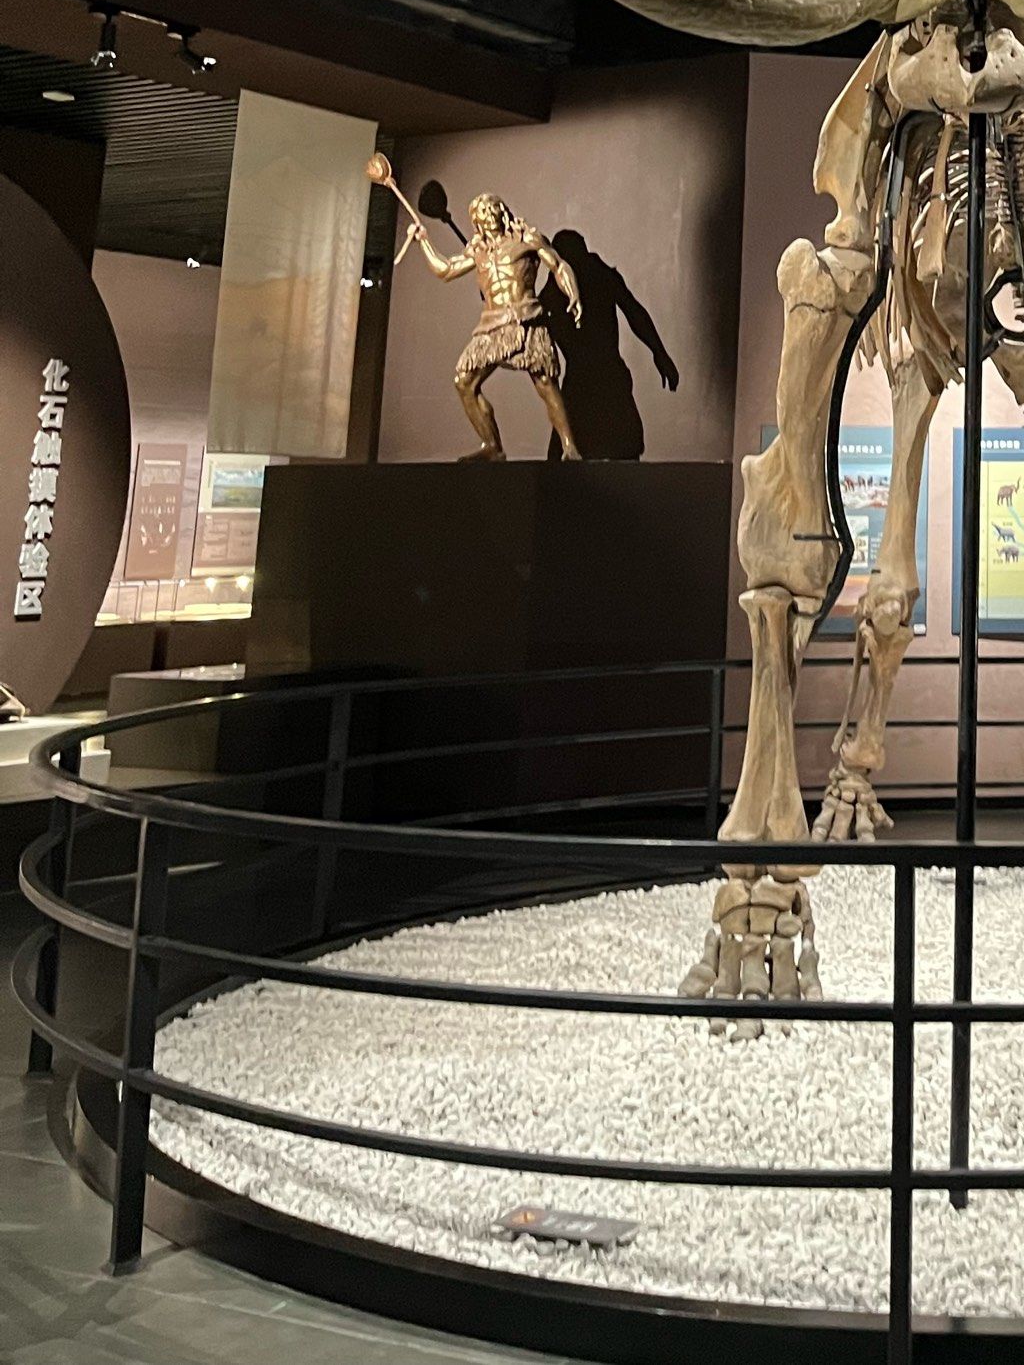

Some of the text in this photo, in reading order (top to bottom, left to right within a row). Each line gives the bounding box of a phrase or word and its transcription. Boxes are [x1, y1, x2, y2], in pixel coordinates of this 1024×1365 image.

[14, 358, 70, 617] 化石触摸体验区
